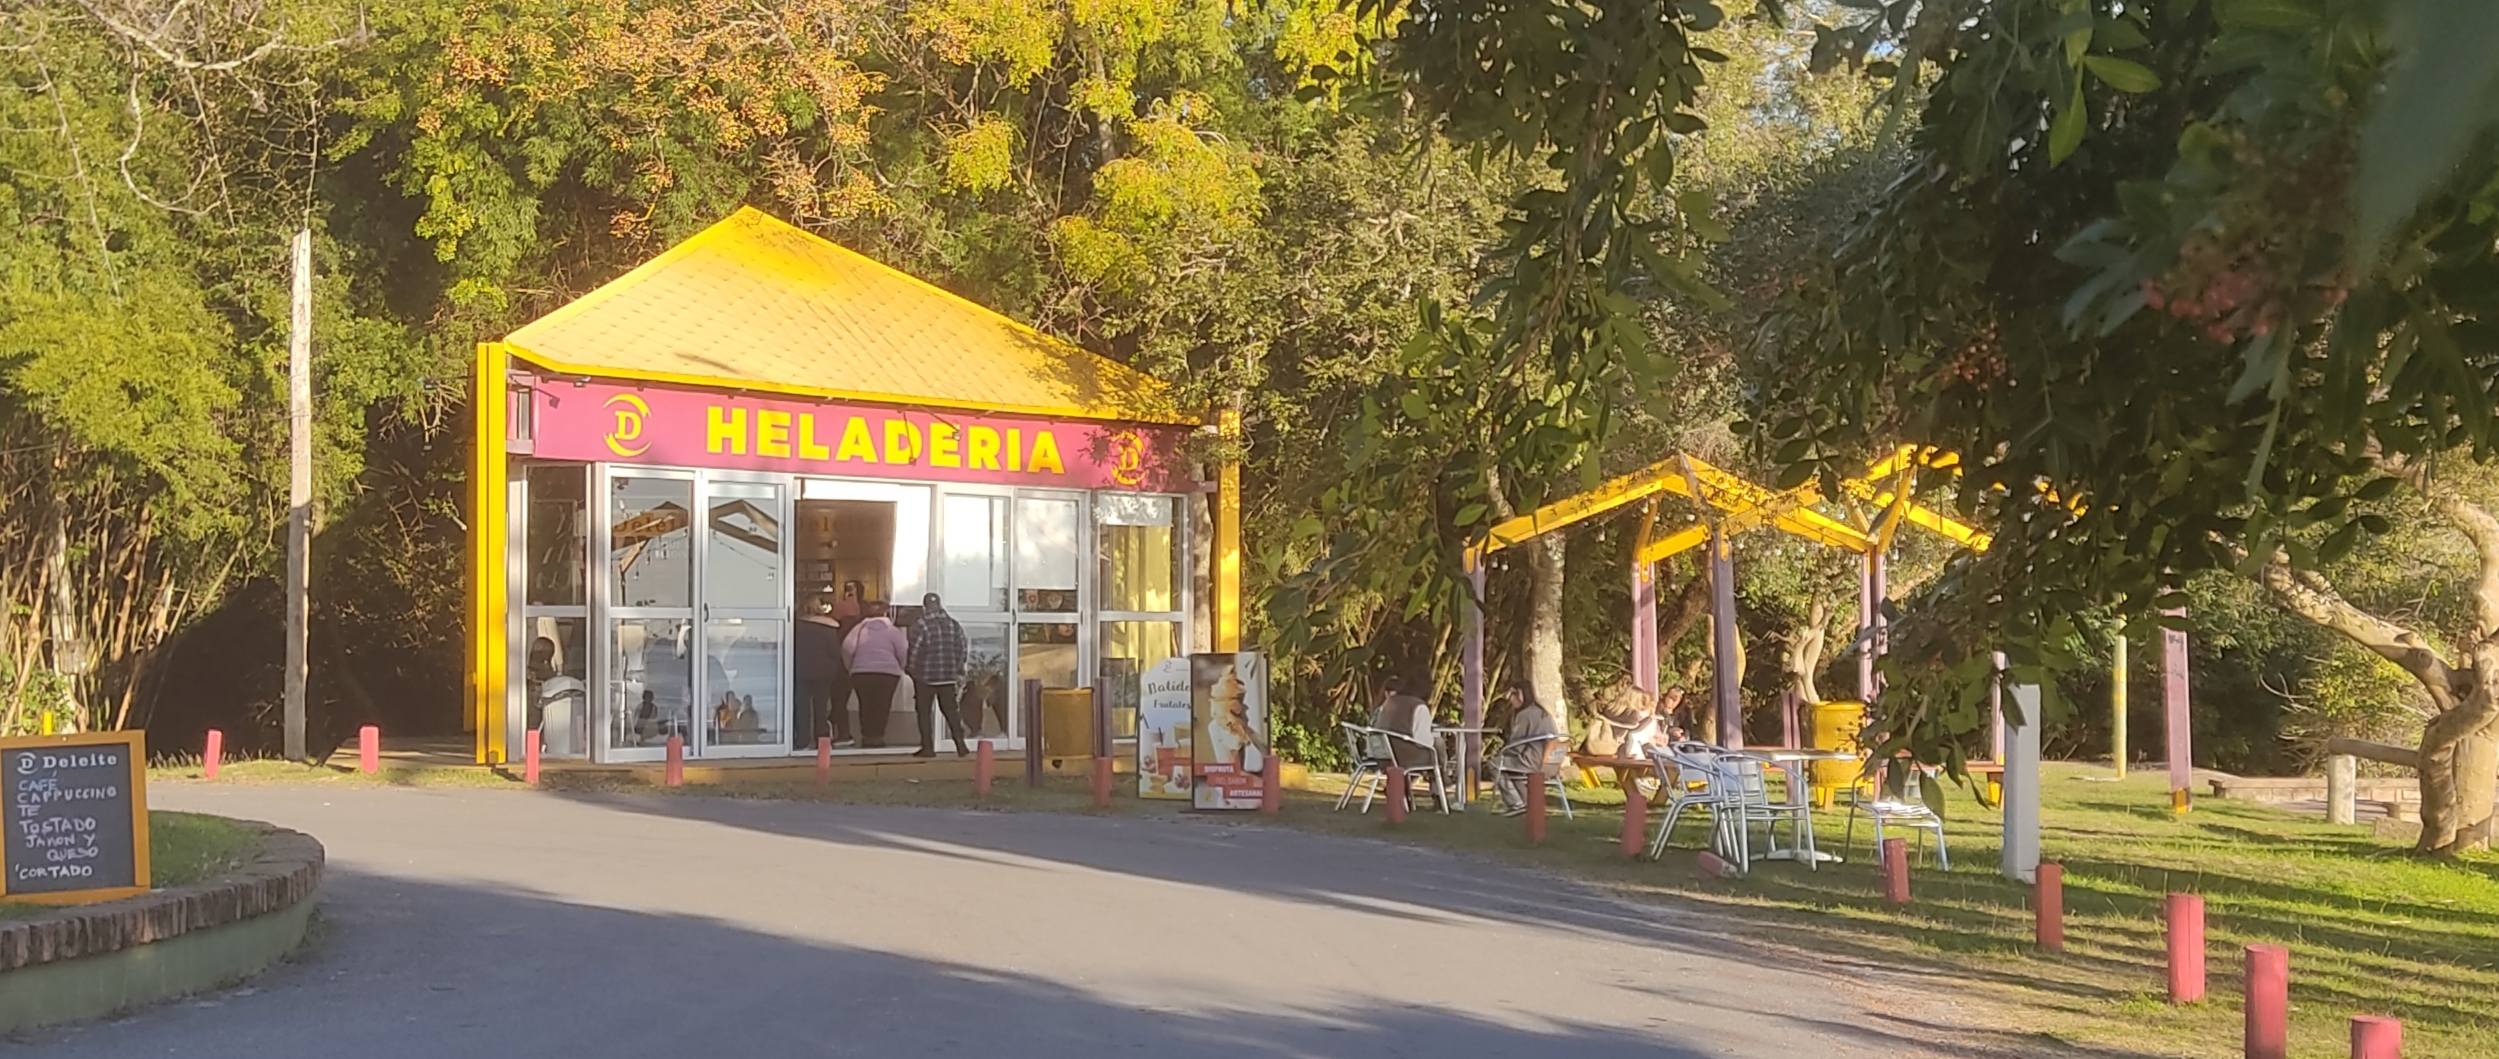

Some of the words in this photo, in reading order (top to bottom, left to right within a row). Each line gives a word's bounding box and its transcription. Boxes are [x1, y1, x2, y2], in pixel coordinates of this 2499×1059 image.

[706, 406, 1066, 475] HELADERIA
[42, 753, 117, 769] Deleite
[18, 771, 58, 792] CAFÉ
[17, 786, 117, 803] CAPPUCCINO
[17, 804, 41, 817] TE
[19, 817, 96, 835] TOSTADO
[83, 833, 96, 847] Y
[46, 846, 99, 862] QUESO
